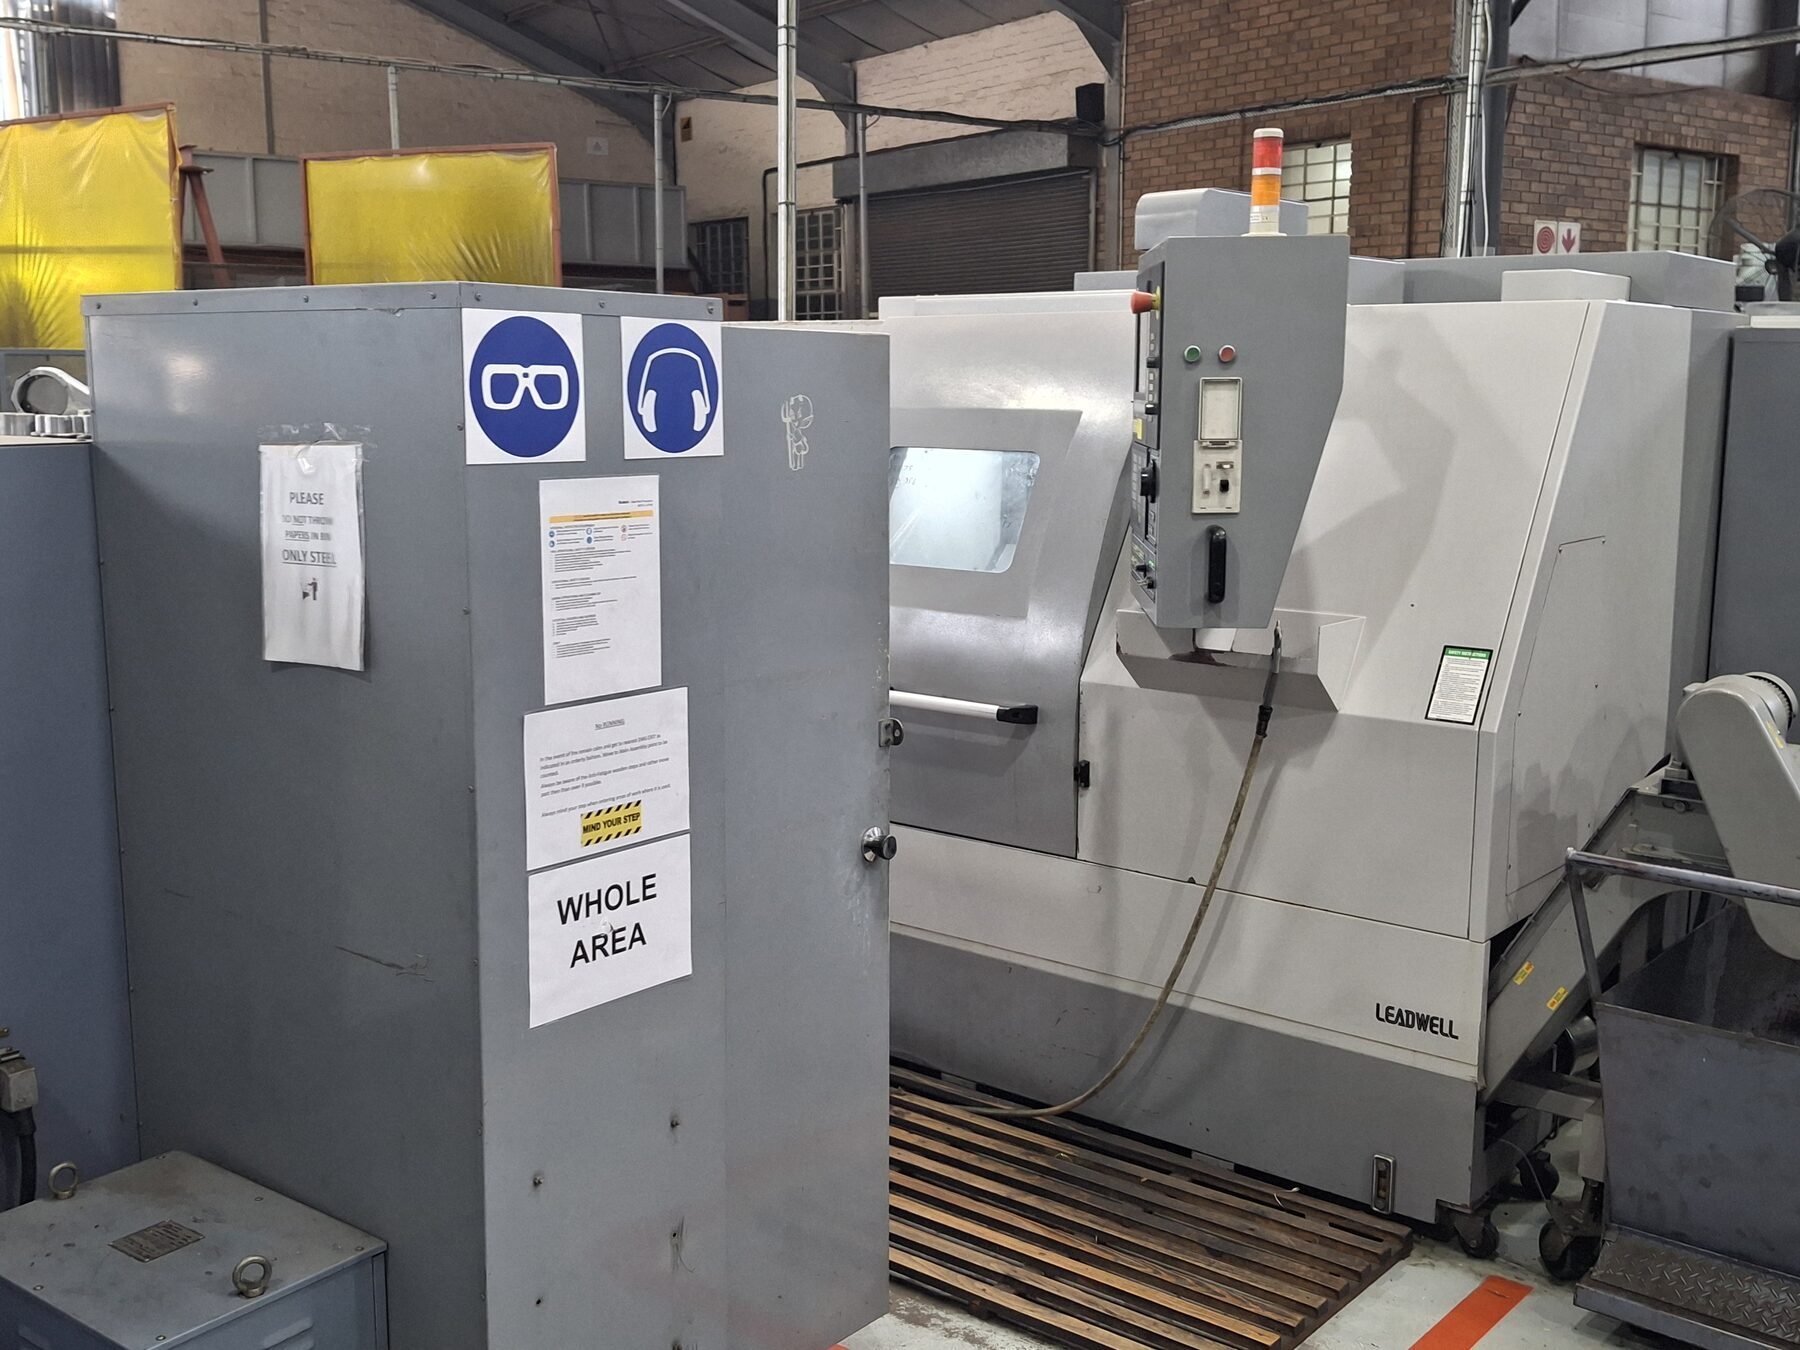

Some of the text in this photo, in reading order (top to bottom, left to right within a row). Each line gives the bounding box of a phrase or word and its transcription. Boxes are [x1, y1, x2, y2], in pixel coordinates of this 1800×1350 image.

[289, 491, 325, 506] PLEASE
[282, 548, 337, 565] ONLY STEEL
[582, 812, 641, 834] MIND YOUR STEP
[557, 873, 657, 925] WHOLE
[570, 922, 647, 968] AREA
[1375, 1002, 1459, 1040] LEADWELL
